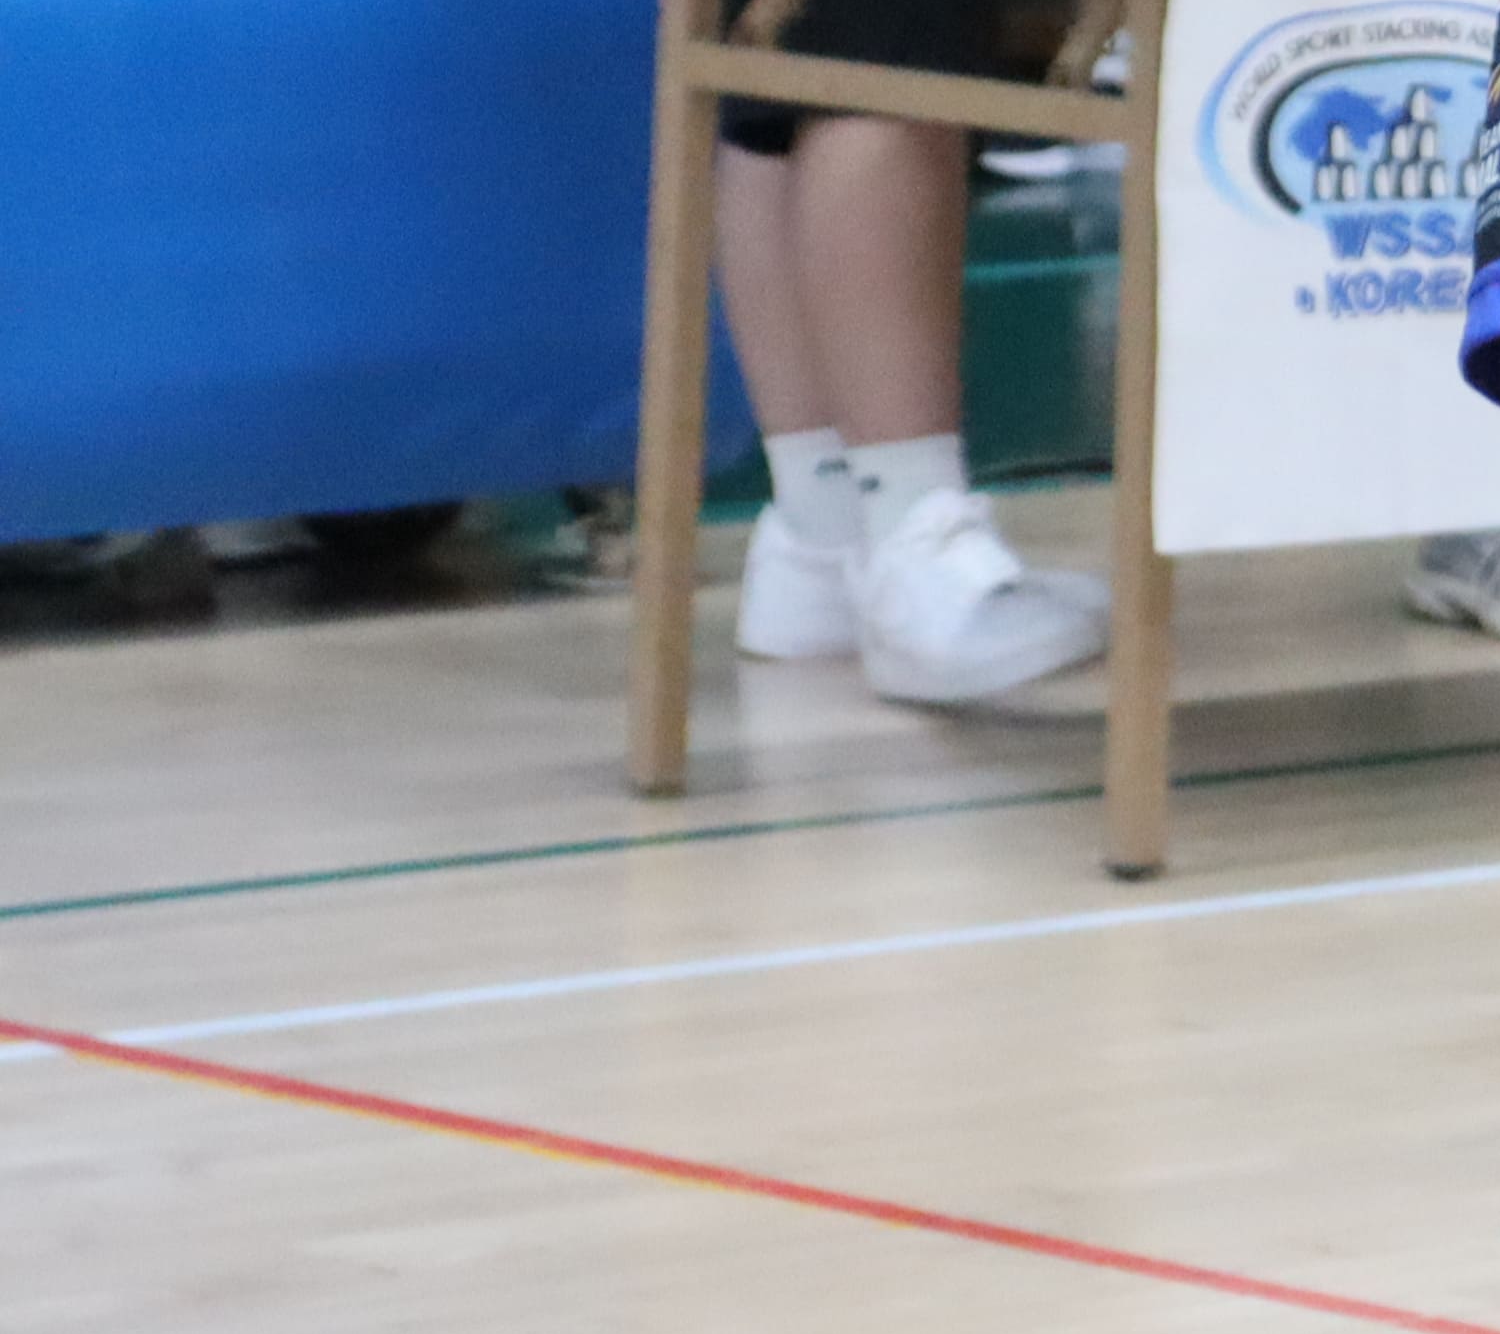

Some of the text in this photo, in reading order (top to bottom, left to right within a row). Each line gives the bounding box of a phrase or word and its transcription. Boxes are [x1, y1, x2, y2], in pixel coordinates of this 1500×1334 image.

[1284, 22, 1353, 60] SPORT
[1362, 20, 1461, 43] STACKING
[1326, 212, 1475, 261] WSS
[1324, 267, 1467, 320] KORE
